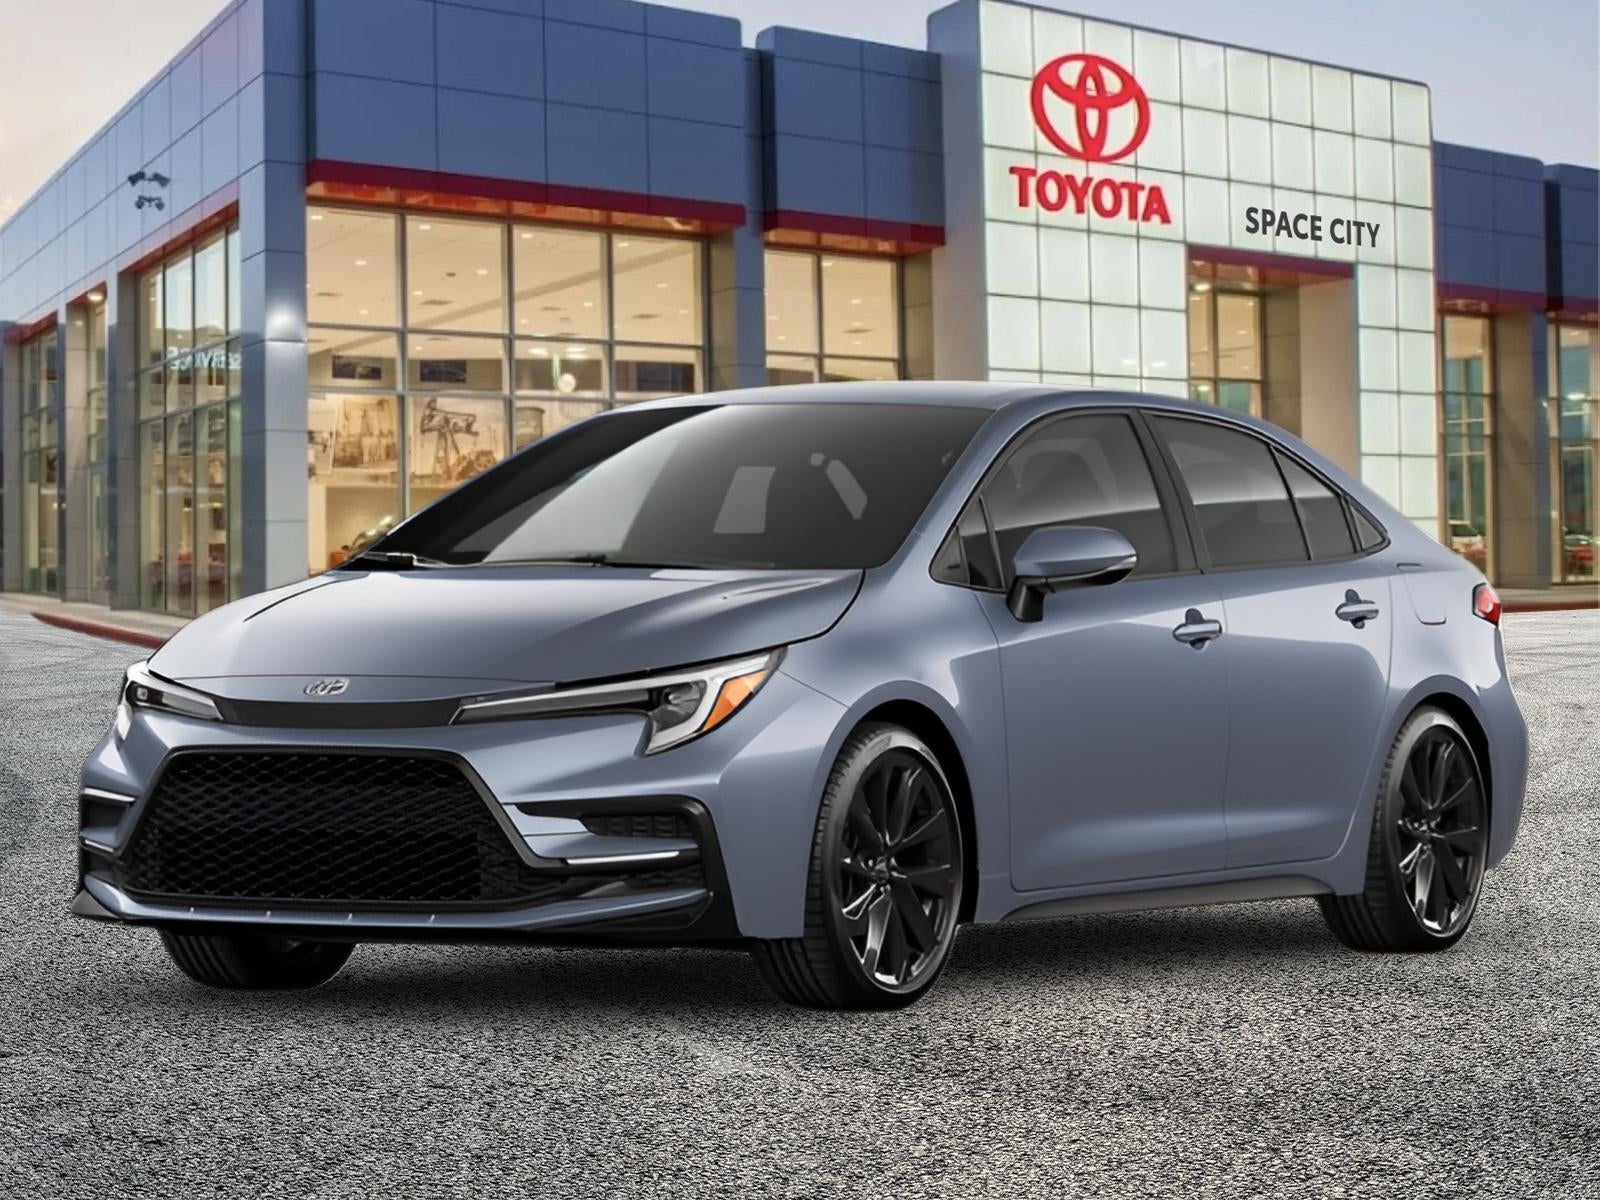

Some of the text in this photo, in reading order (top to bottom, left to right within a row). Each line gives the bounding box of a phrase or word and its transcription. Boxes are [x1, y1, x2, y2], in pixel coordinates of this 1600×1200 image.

[1009, 166, 1171, 224] TOYOTA
[1245, 207, 1380, 247] SPACE CITY
